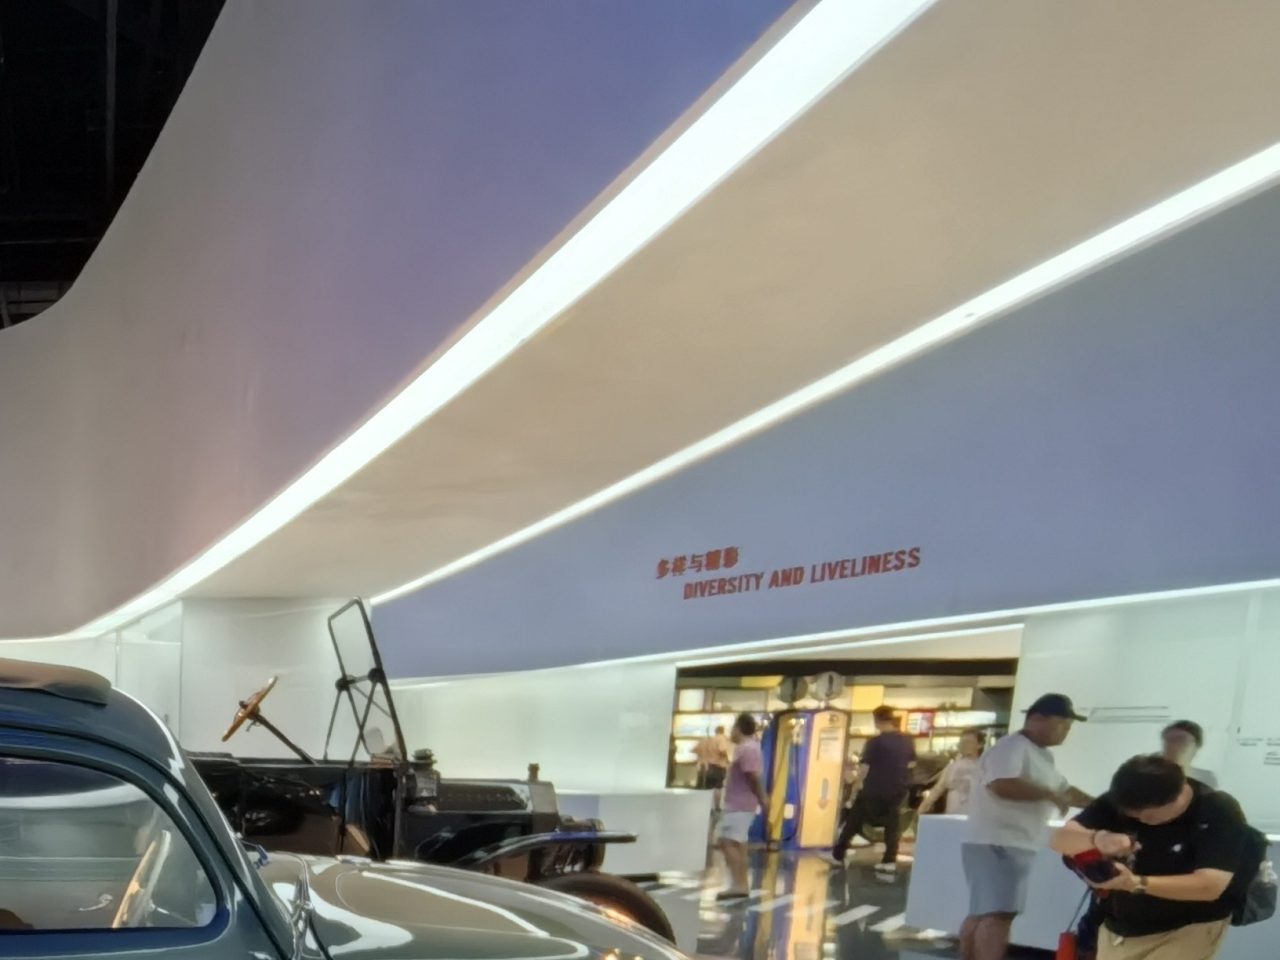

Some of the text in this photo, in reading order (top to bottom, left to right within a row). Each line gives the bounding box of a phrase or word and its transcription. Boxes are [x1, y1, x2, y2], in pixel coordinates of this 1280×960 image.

[683, 547, 922, 600] DIVERSITY AND LIVELINESS
